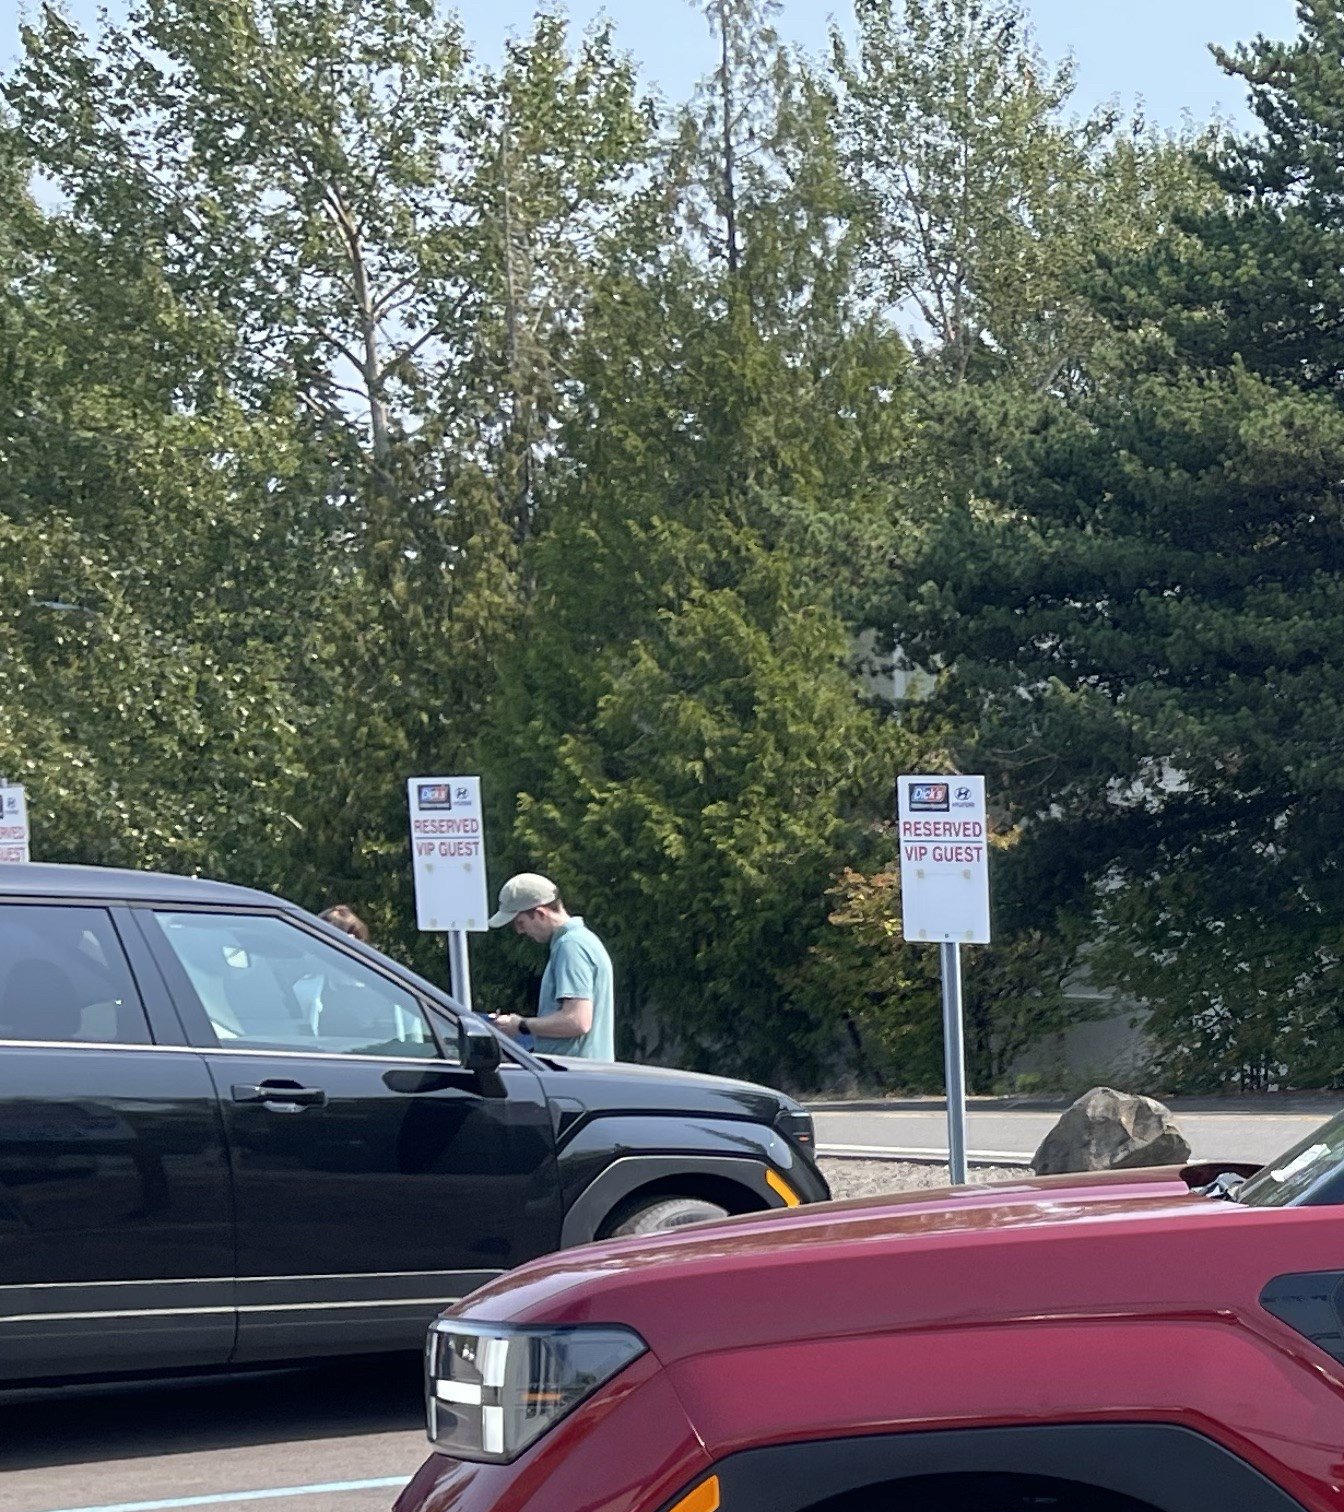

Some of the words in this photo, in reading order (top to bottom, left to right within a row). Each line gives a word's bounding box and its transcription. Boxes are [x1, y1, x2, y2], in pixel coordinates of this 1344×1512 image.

[413, 818, 479, 834] RESERVED
[903, 821, 982, 837] RESERVED
[416, 842, 435, 856] VIP
[438, 841, 480, 857] GUEST
[904, 846, 928, 862] VIP
[933, 846, 983, 862] GUEST
